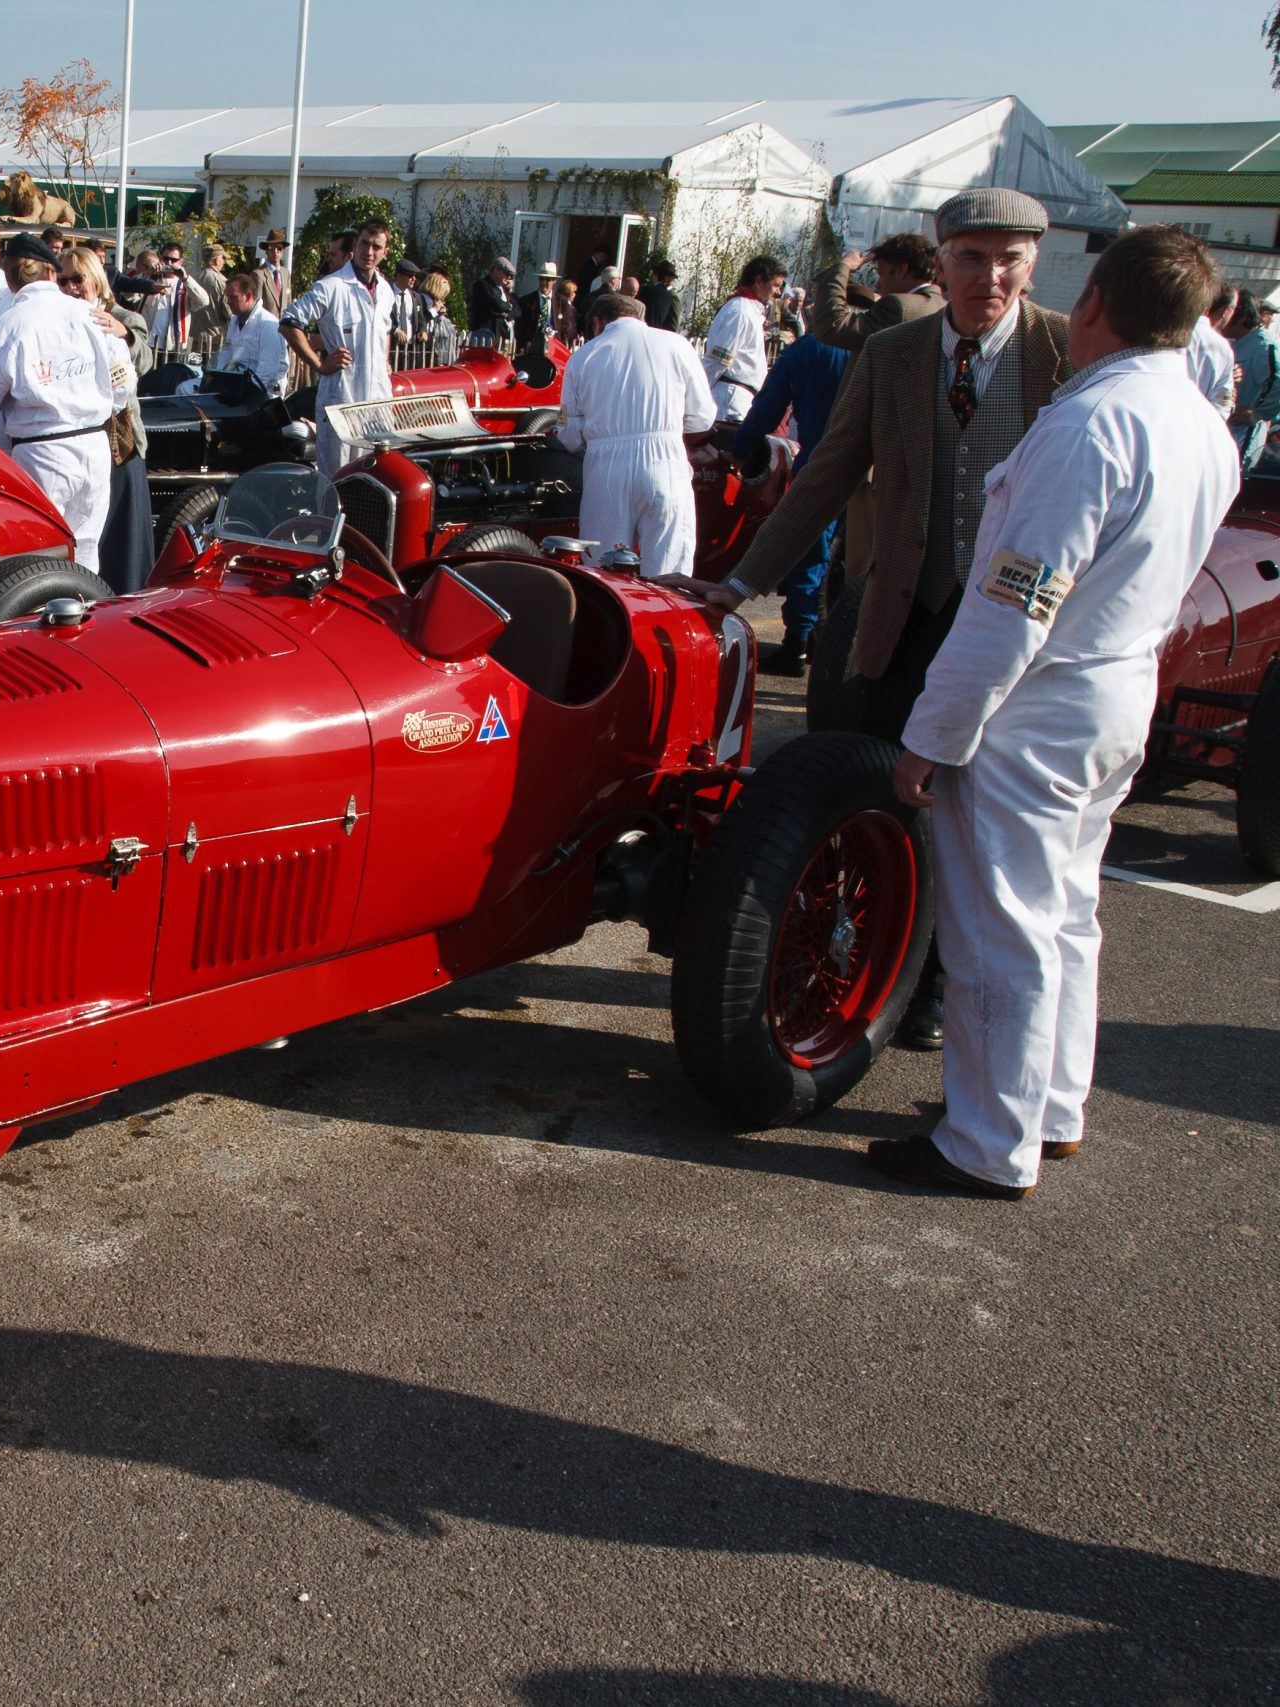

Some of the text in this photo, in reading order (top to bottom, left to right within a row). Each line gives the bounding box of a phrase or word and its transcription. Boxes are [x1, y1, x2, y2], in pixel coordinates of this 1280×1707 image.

[422, 715, 455, 730] HISTORIC
[408, 721, 470, 742] GRAND PRIX CARS
[418, 732, 463, 749] ASSOCIATION
